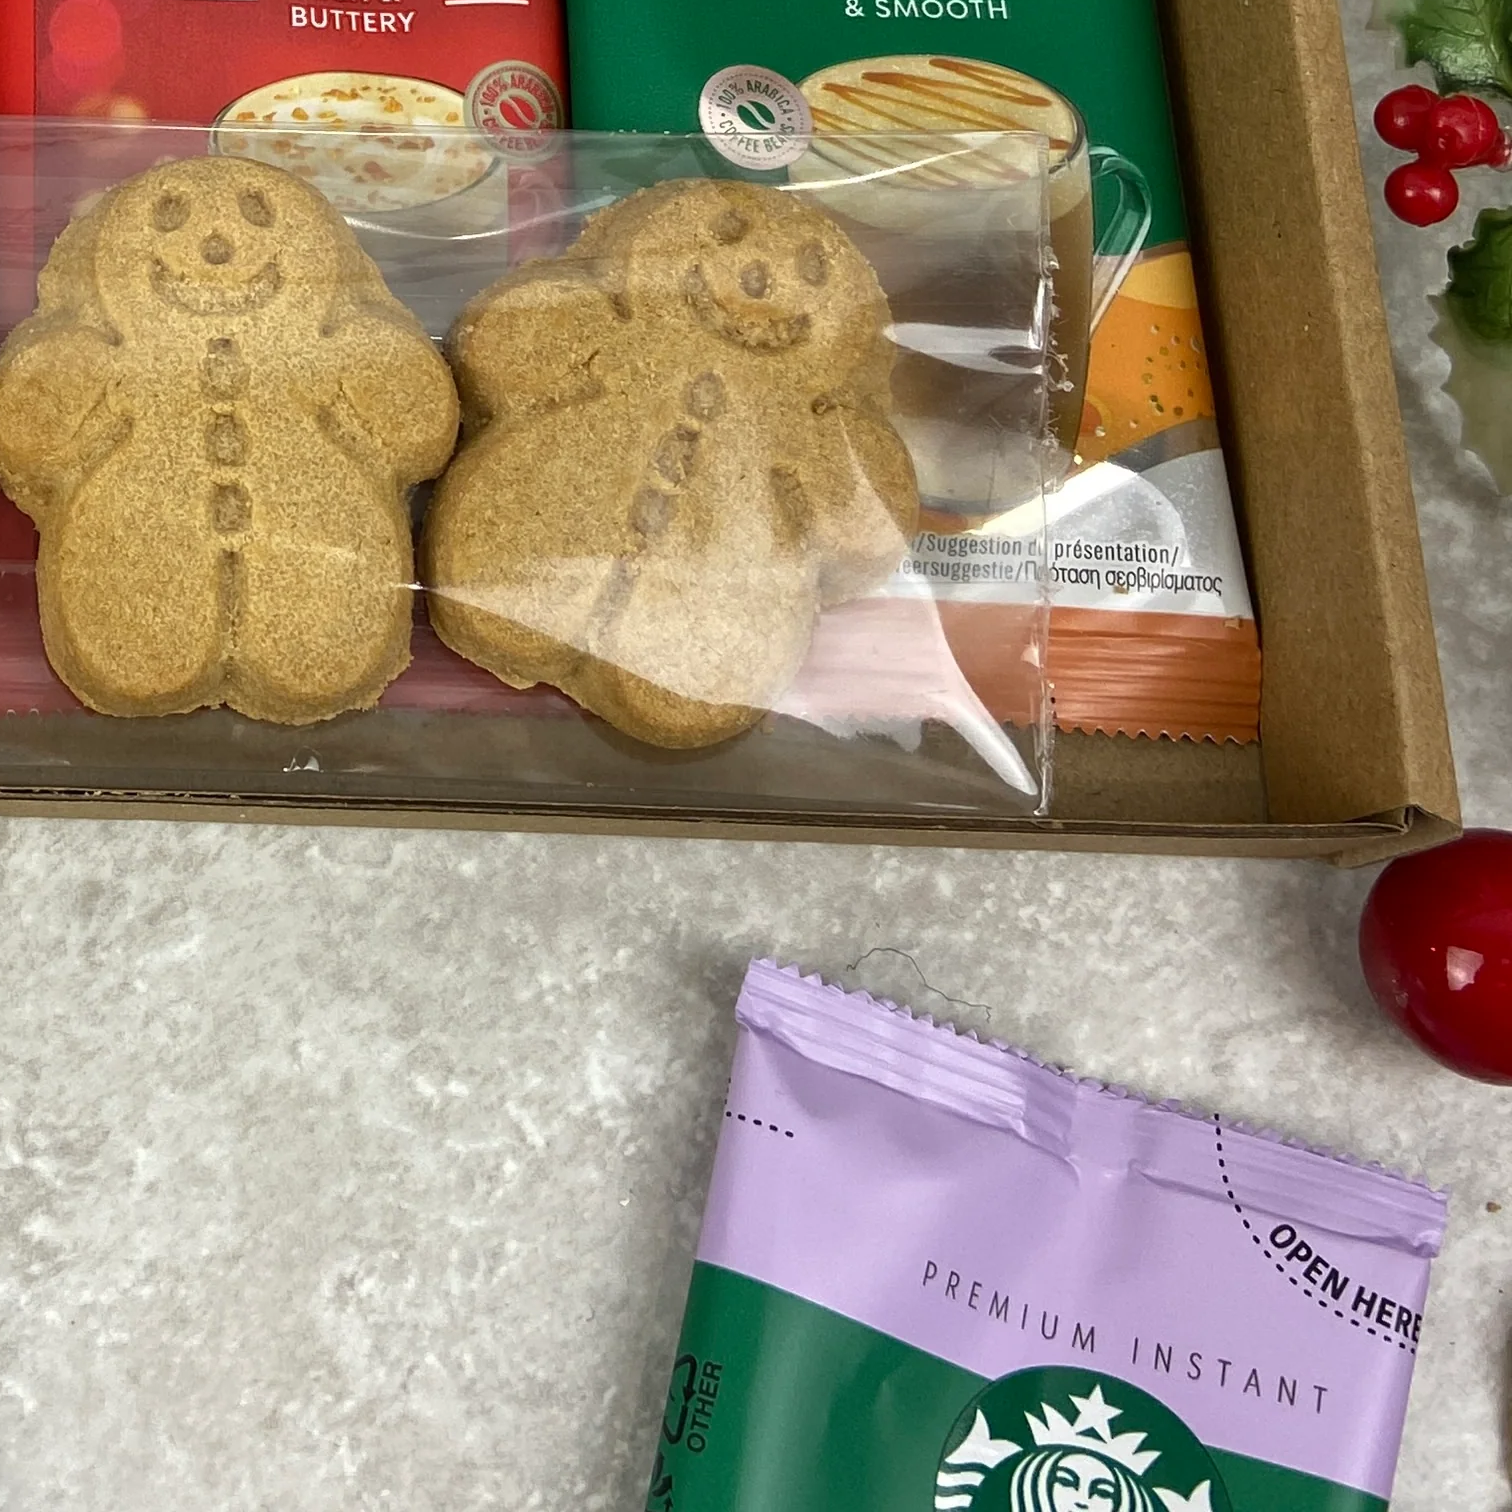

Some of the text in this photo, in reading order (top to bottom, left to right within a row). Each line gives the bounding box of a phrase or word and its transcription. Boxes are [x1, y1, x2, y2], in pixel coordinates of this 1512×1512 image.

[290, 6, 416, 34] BUTTERY
[716, 79, 794, 116] 100% ARABICA
[1269, 1224, 1423, 1344] OPEN HERE
[922, 1259, 1331, 1415] PREMIUM INSTANT
[687, 1360, 723, 1453] OTHER
